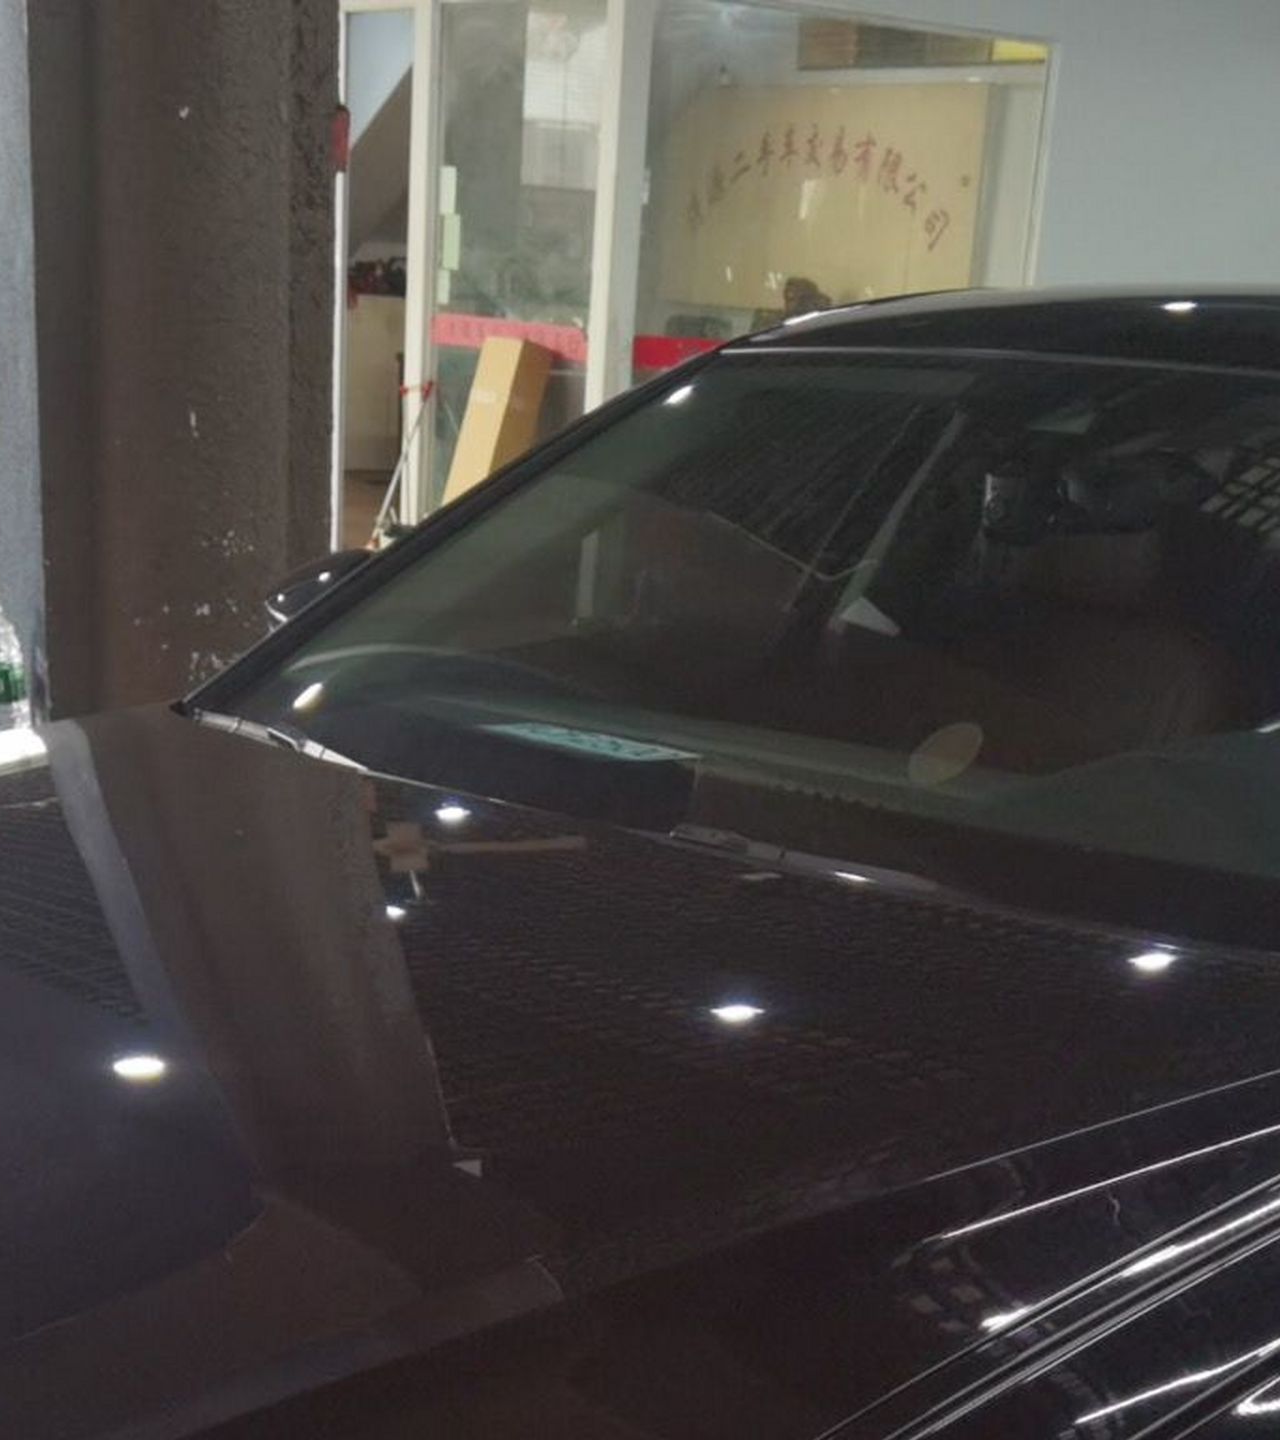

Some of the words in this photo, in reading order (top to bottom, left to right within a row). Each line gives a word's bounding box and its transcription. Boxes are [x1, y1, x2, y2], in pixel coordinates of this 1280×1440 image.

[685, 123, 950, 252] 二手车交易有限公司
